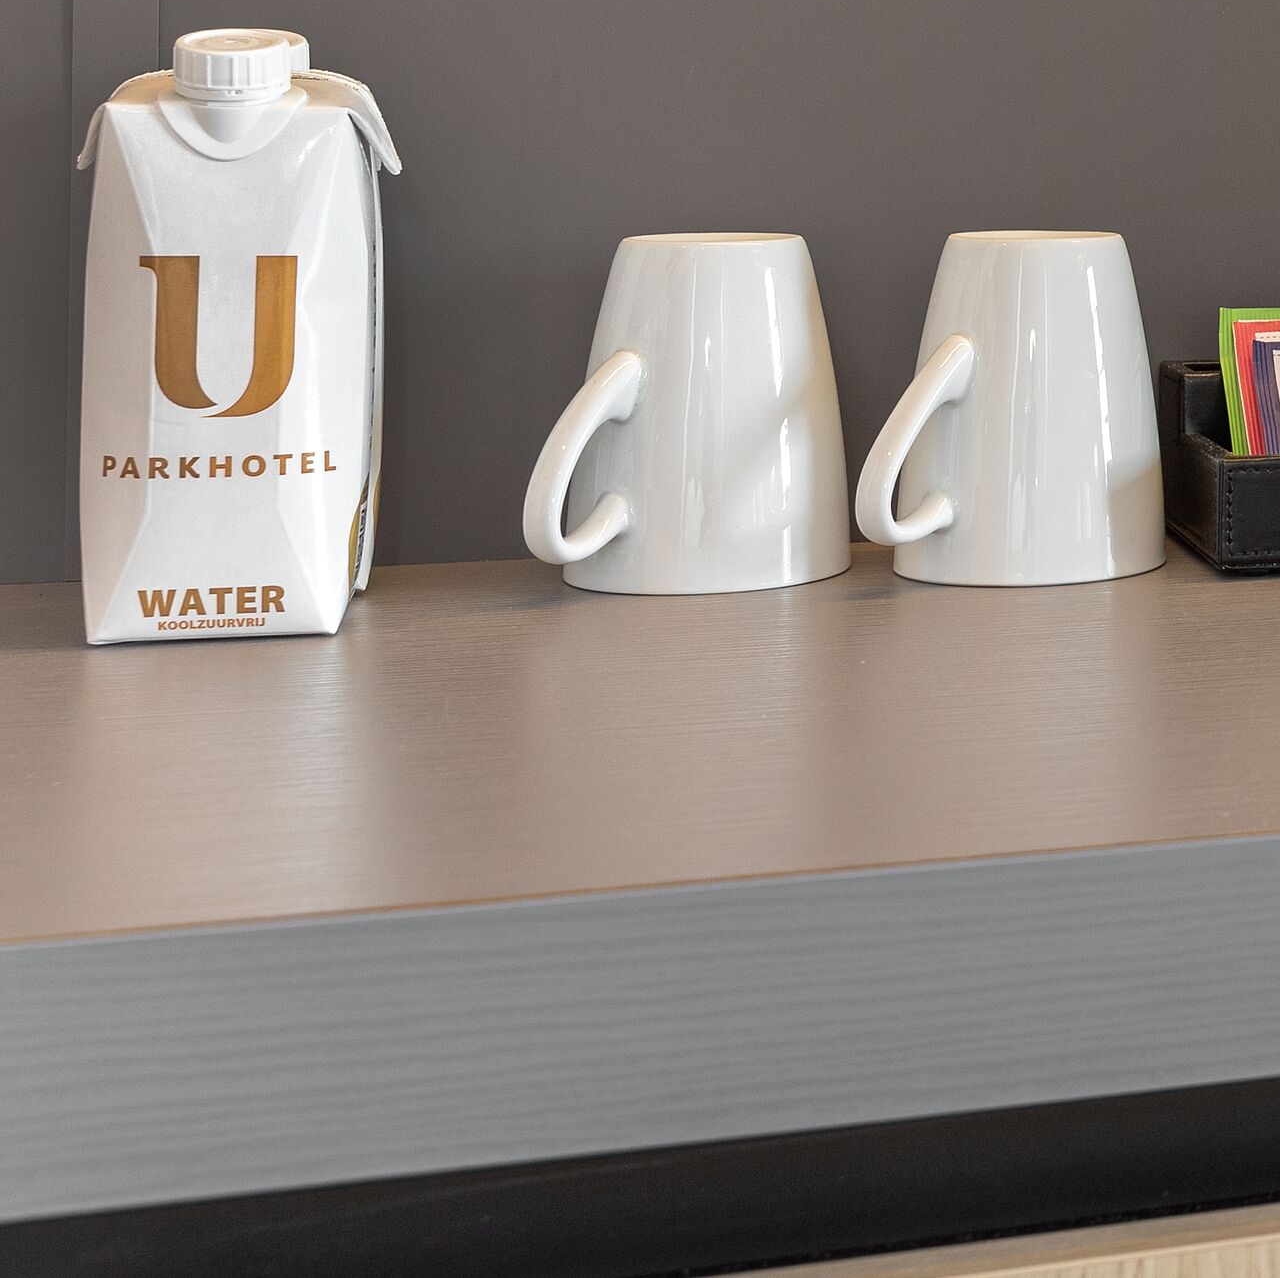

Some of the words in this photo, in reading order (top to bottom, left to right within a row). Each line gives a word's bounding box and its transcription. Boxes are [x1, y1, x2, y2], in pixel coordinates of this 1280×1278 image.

[138, 255, 298, 418] U
[102, 450, 337, 480] PARKHOTEL
[137, 585, 286, 618] WATER
[157, 617, 266, 631] KOOLZUURVRIJ
